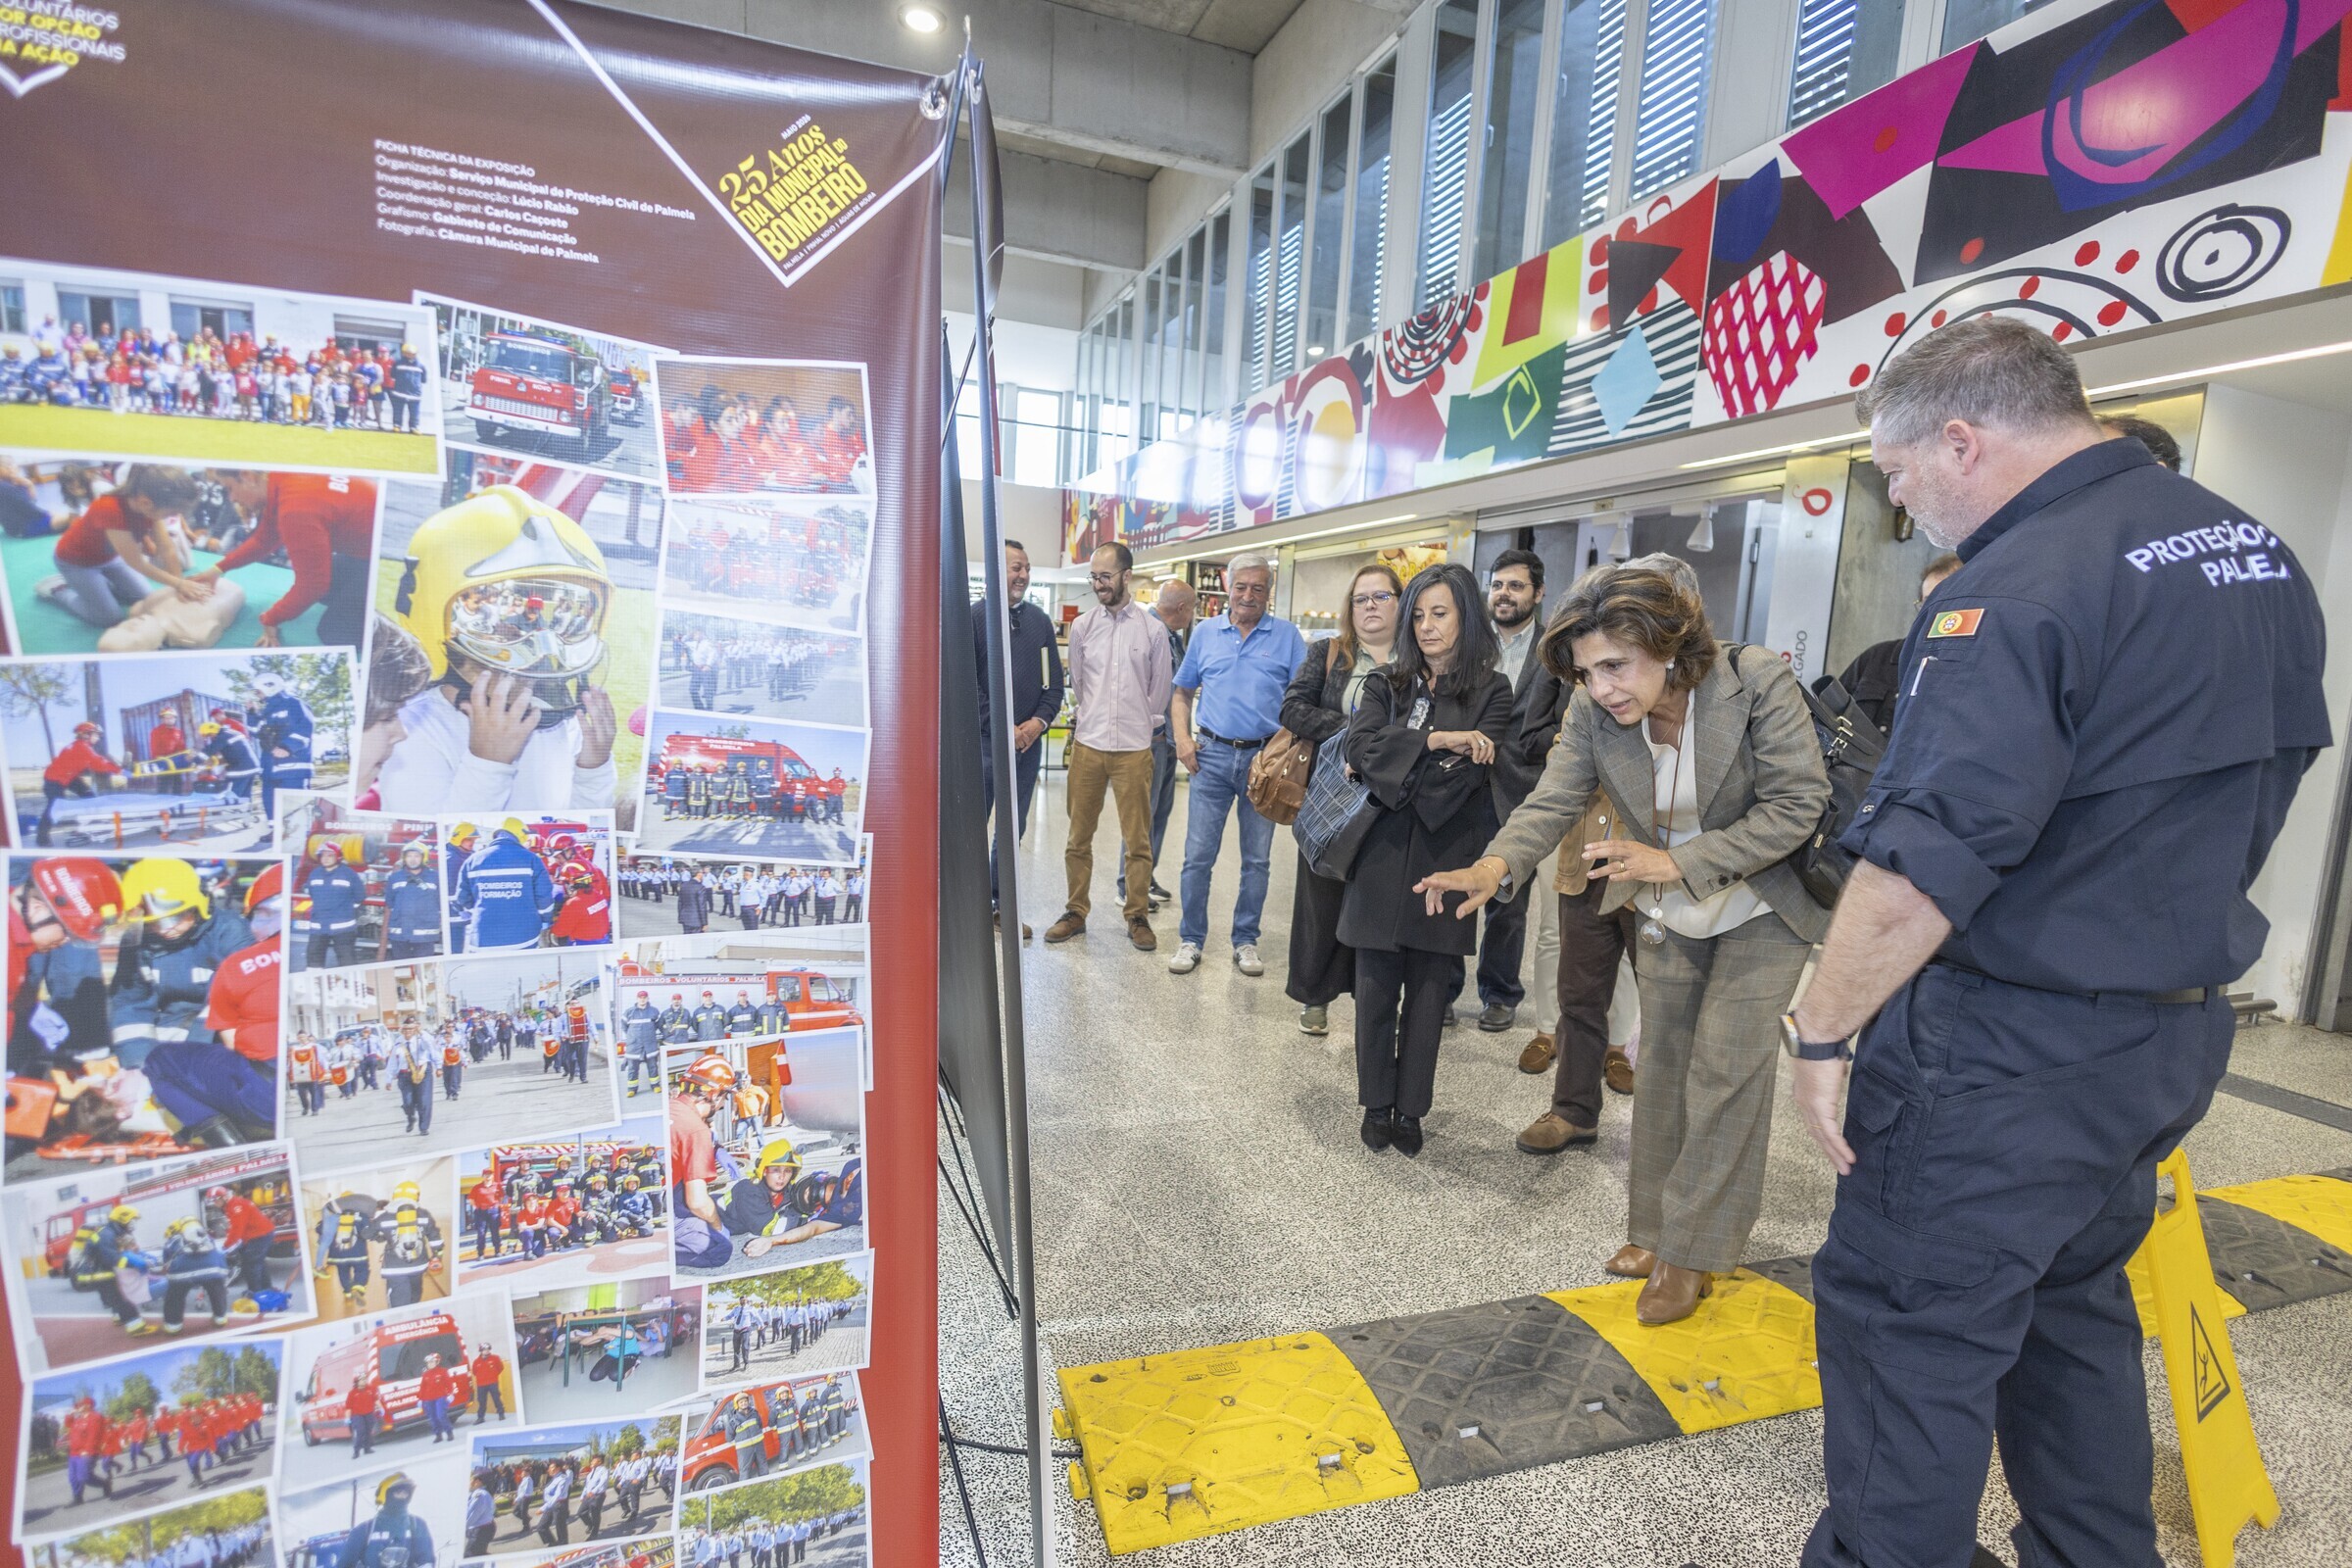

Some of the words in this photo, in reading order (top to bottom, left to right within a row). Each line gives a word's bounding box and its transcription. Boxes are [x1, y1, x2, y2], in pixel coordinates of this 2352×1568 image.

[0, 7, 26, 24] OR
[0, 23, 125, 63] ROFISSIONAIS
[0, 39, 17, 54] A
[374, 139, 409, 155] FICHA
[410, 145, 458, 164] TÉCNICA
[458, 155, 474, 167] DA
[475, 158, 535, 177] EXPOSIÇÃO
[718, 155, 768, 213] 25
[767, 124, 826, 181] Anos
[376, 171, 447, 193] Investigação
[447, 184, 456, 194] e
[513, 194, 543, 210] Lúcio
[449, 168, 493, 186] Serviço
[494, 176, 548, 196] Municipal
[550, 186, 564, 198] de
[565, 188, 613, 206] Proteção
[615, 197, 639, 211] Civil
[640, 202, 654, 213] de
[655, 204, 696, 220] Palmela
[737, 199, 775, 234] DIA
[762, 142, 847, 214] MUNICIPAL
[832, 137, 849, 154] DO
[376, 186, 453, 209] Coordenação
[484, 205, 521, 221] Carlos
[522, 212, 568, 229] Caçoete
[755, 162, 868, 262] BOMBEIRO
[432, 212, 486, 230] Gabinete
[487, 221, 502, 233] de
[503, 223, 577, 245] Comunicação
[438, 227, 484, 244] Câmara
[485, 235, 539, 255] Municipal
[540, 245, 555, 257] de
[555, 247, 600, 264] Palmela
[2124, 519, 2262, 573] PROTEÇÃO
